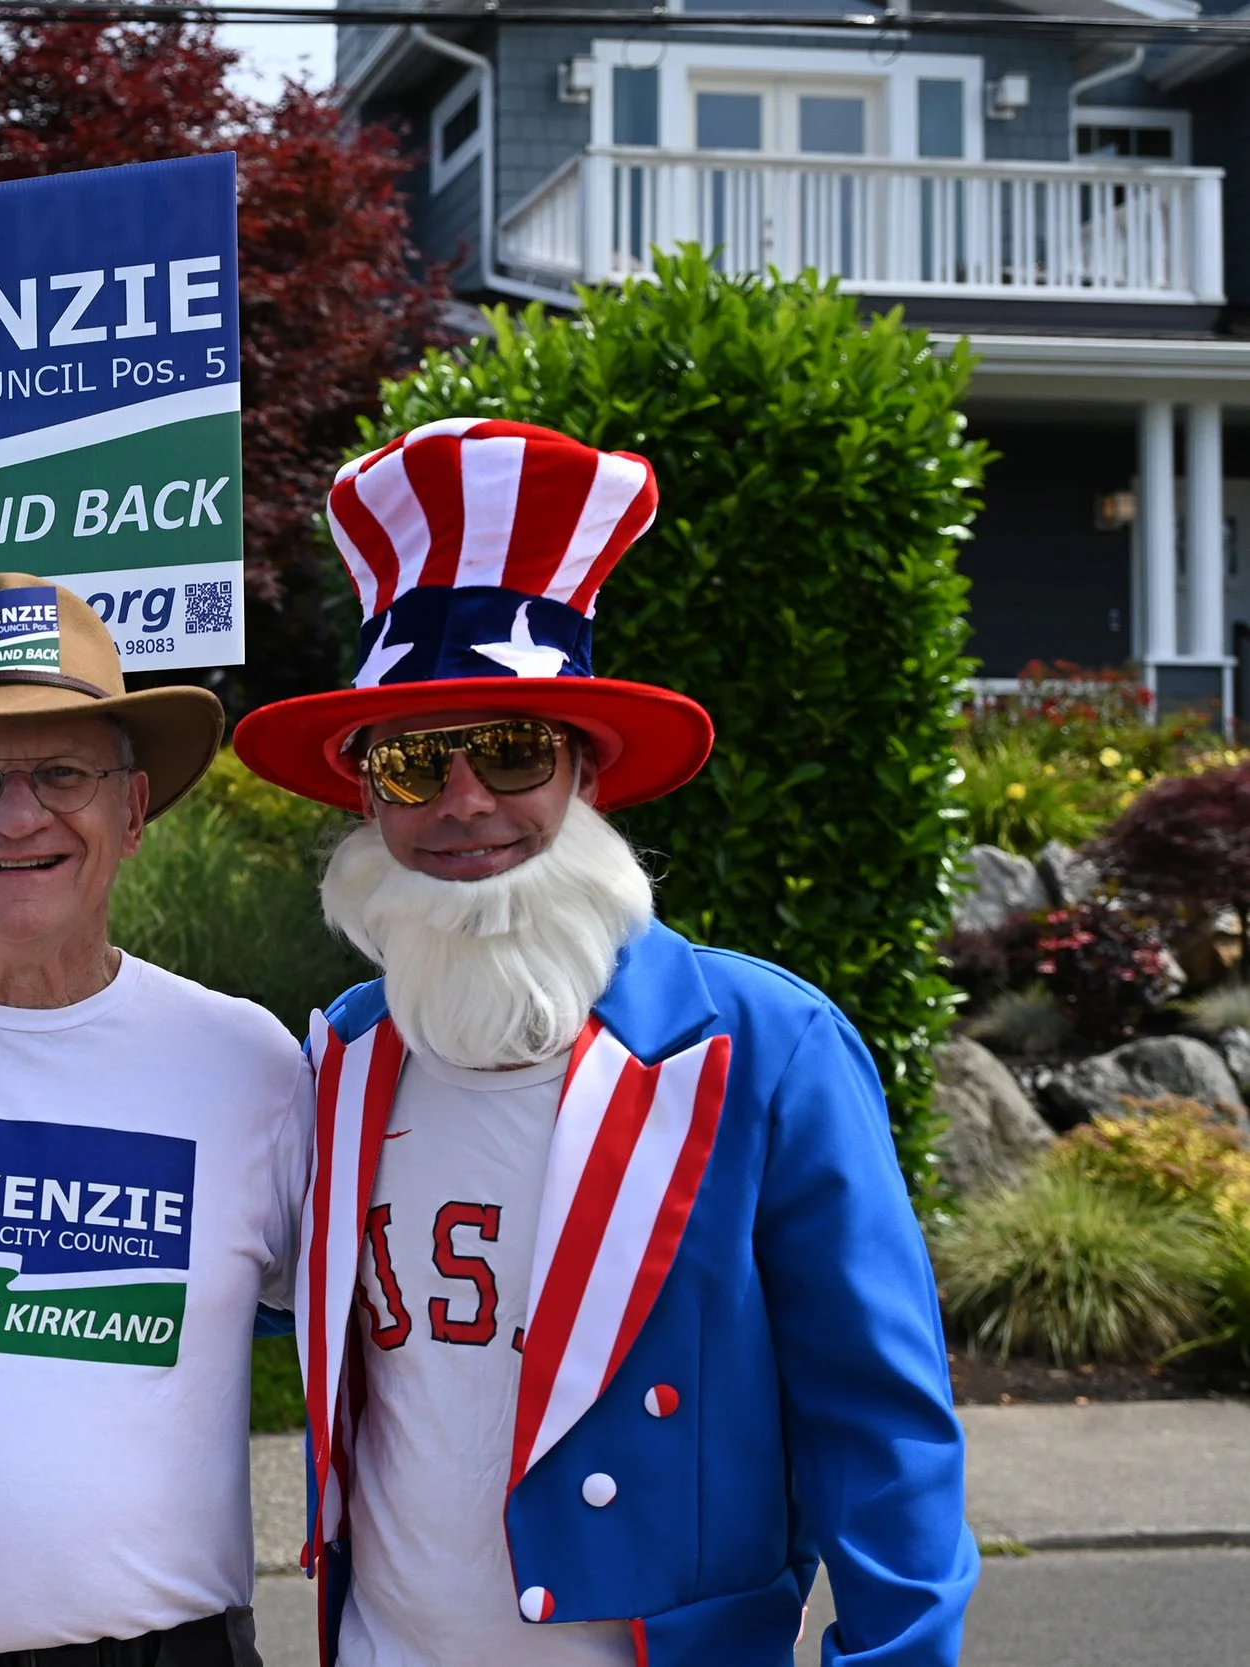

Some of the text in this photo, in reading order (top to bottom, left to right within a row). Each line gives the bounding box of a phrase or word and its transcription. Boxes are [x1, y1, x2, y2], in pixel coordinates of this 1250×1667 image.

[111, 357, 186, 389] Pos.
[205, 346, 227, 378] 5
[72, 476, 231, 538] BACK
[32, 622, 50, 631] Pos.
[52, 622, 59, 631] 5
[25, 648, 59, 661] BACK
[125, 637, 175, 655] 98083
[0, 1226, 52, 1248] CITY
[58, 1231, 160, 1259] COUNCIL
[4, 1303, 175, 1344] KIRKLAND
